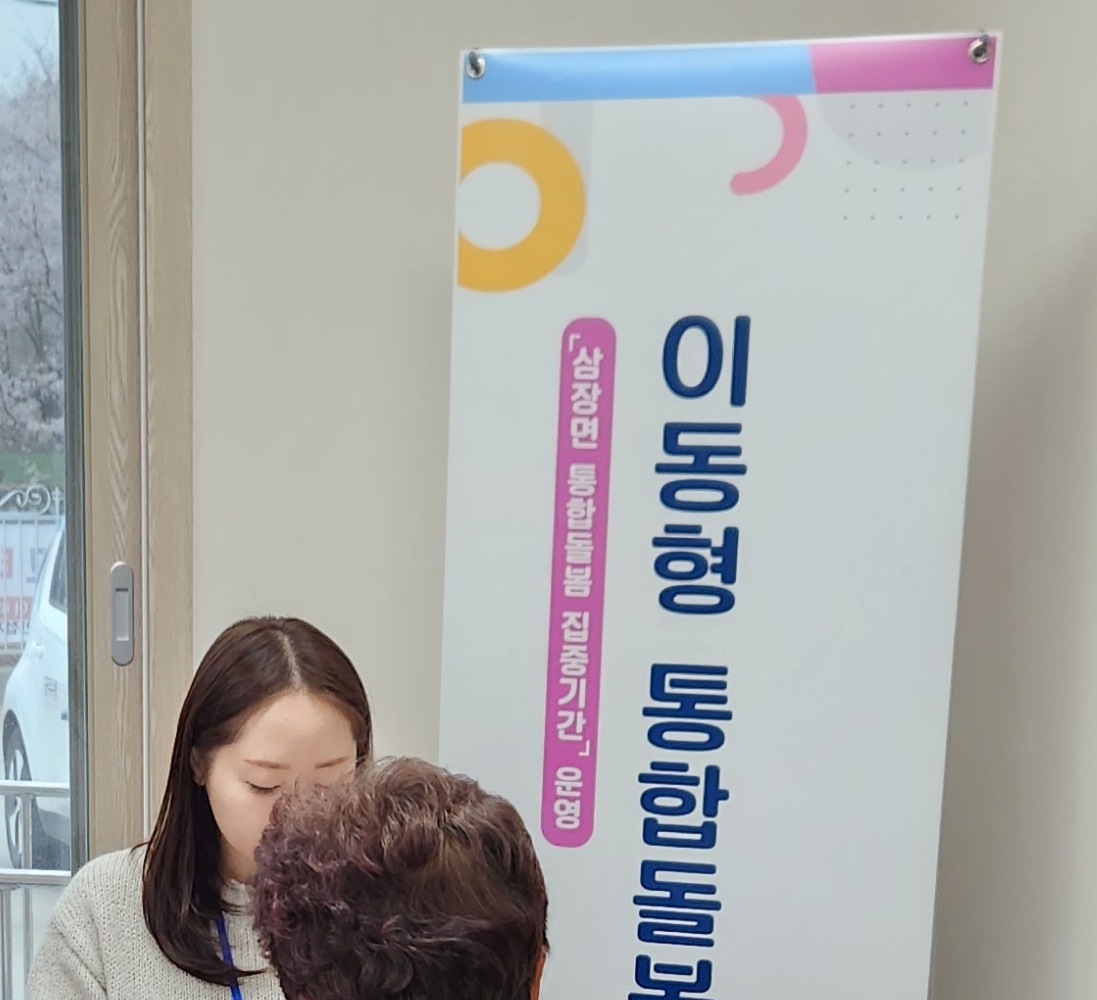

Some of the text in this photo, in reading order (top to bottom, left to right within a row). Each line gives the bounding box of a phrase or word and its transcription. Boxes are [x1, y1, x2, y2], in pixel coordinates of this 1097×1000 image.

[553, 333, 604, 830] 「삼장면 통합돌봄 집중기간」 운영
[652, 315, 751, 615] 이동형
